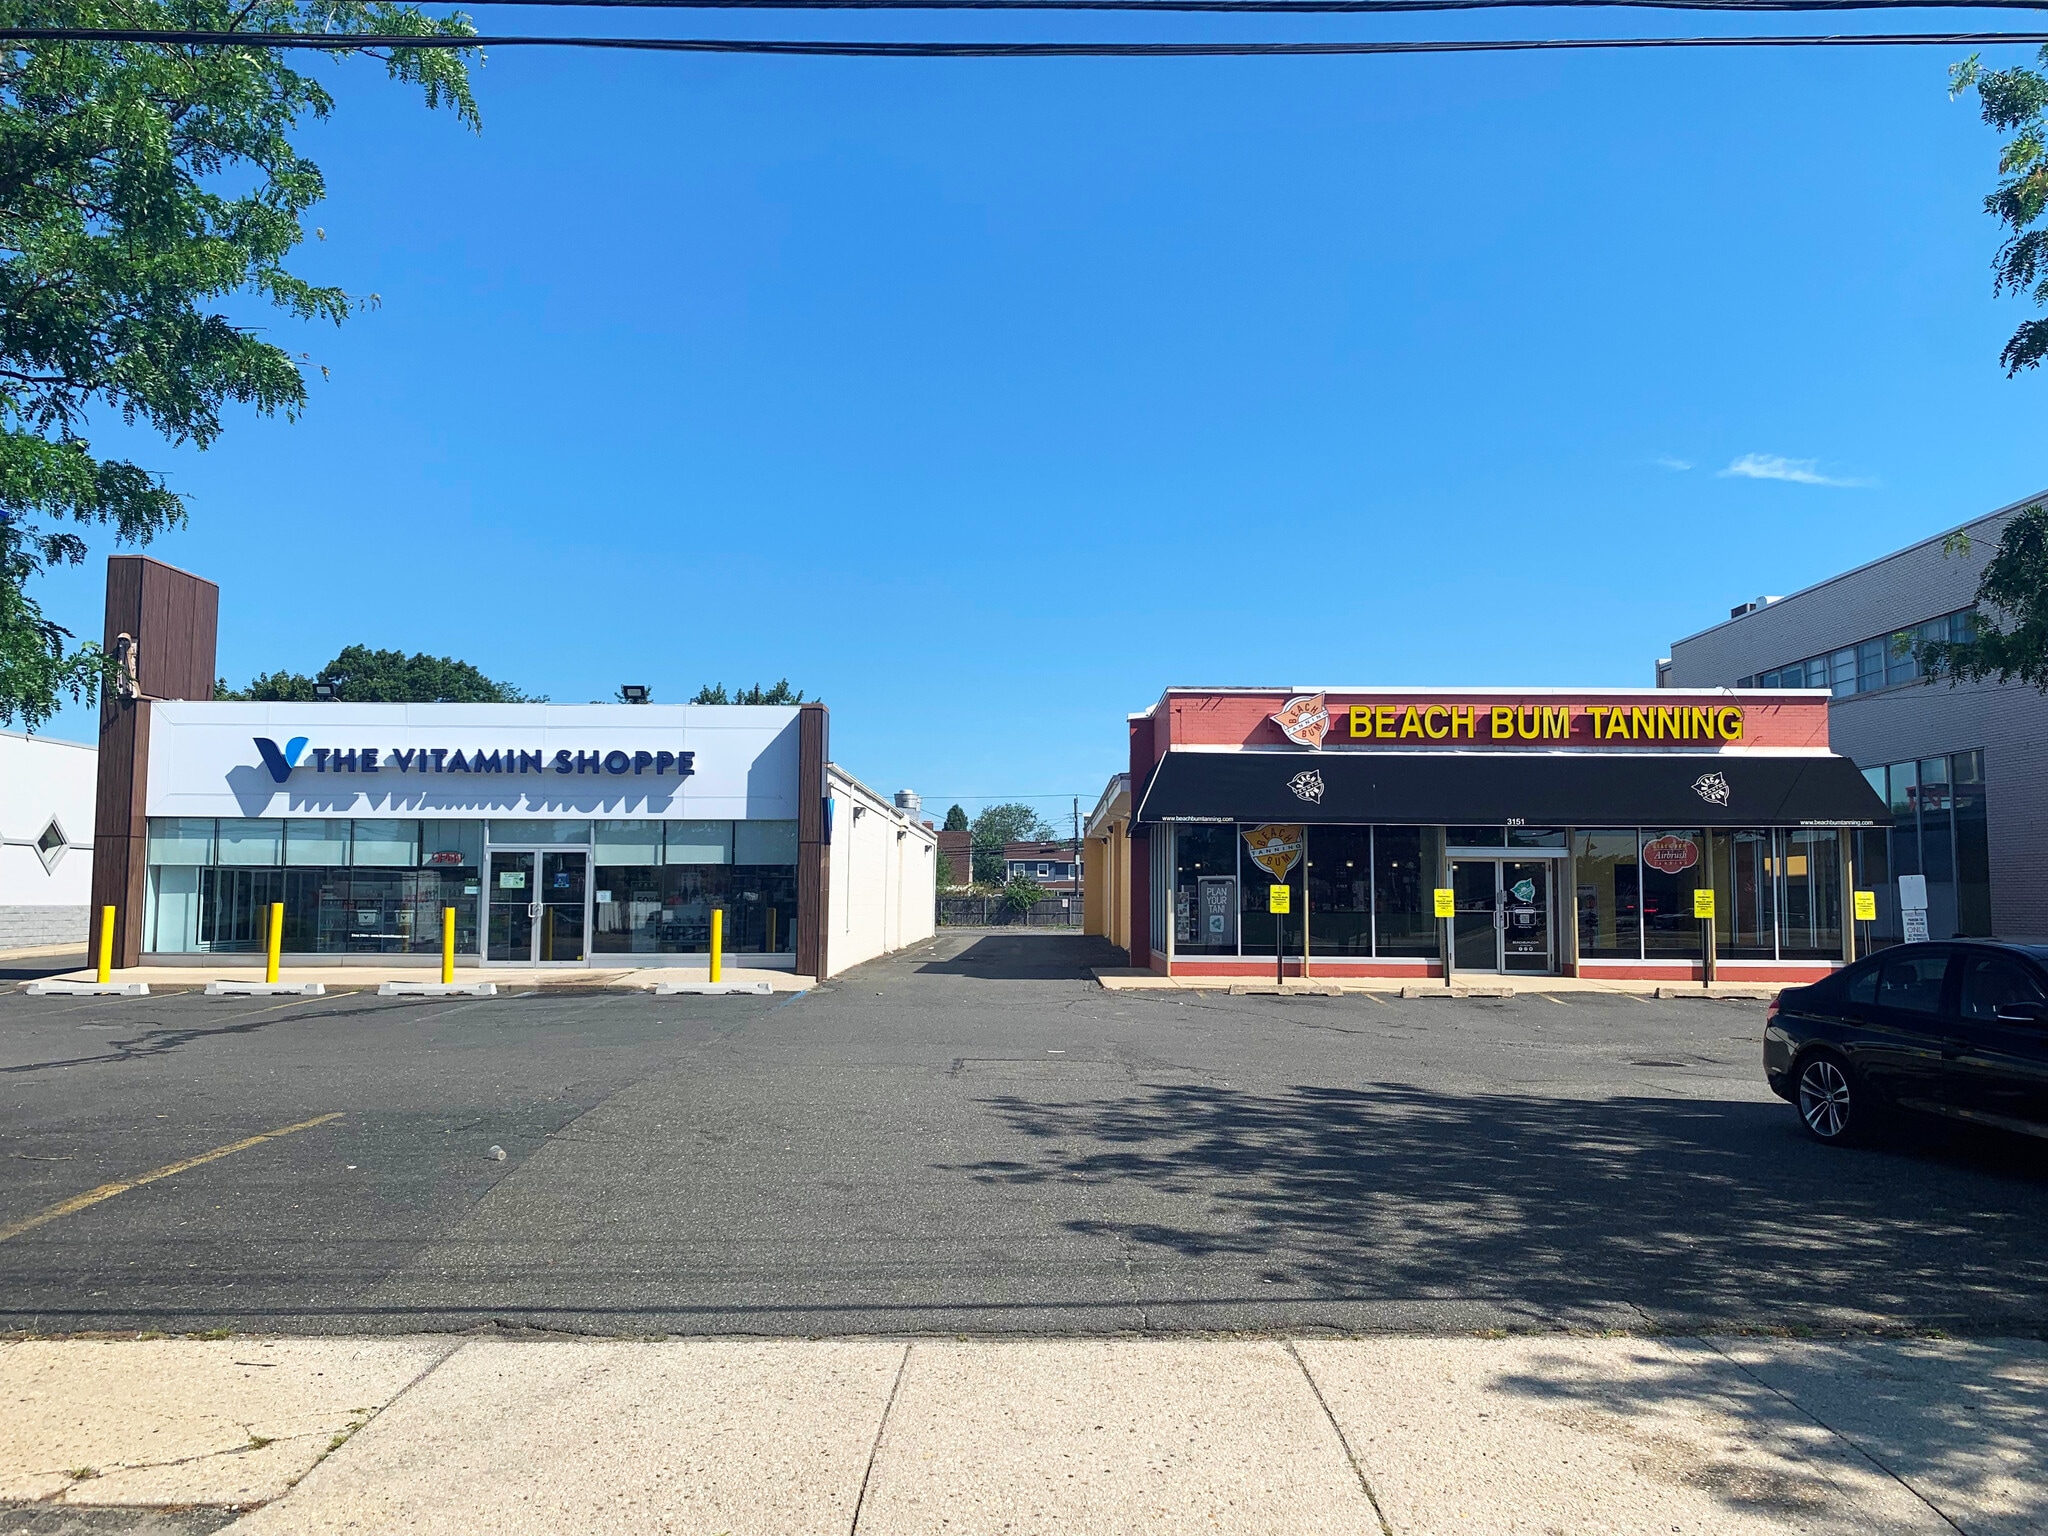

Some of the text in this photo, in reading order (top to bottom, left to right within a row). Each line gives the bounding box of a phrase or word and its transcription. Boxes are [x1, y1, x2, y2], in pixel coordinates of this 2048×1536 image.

[1288, 702, 1318, 724] BEACH
[1349, 705, 1744, 740] BEACH BUM TANNING
[1301, 722, 1322, 738] BUM
[312, 748, 696, 776] THE VITAMIN SHOPPE
[1161, 815, 1234, 823] www.beachbumtanning.com
[1506, 817, 1525, 826] 3151
[1799, 819, 1874, 827] www.beachbumtanning.com
[1256, 827, 1294, 847] BEACH
[1251, 843, 1301, 856] TANNING
[1653, 850, 1688, 860] Airbrush
[432, 852, 462, 863] OPEN
[1266, 853, 1292, 867] BUM
[1206, 887, 1228, 896] PLAN
[1206, 896, 1228, 905] YOUR
[1907, 926, 1925, 934] ONLY
